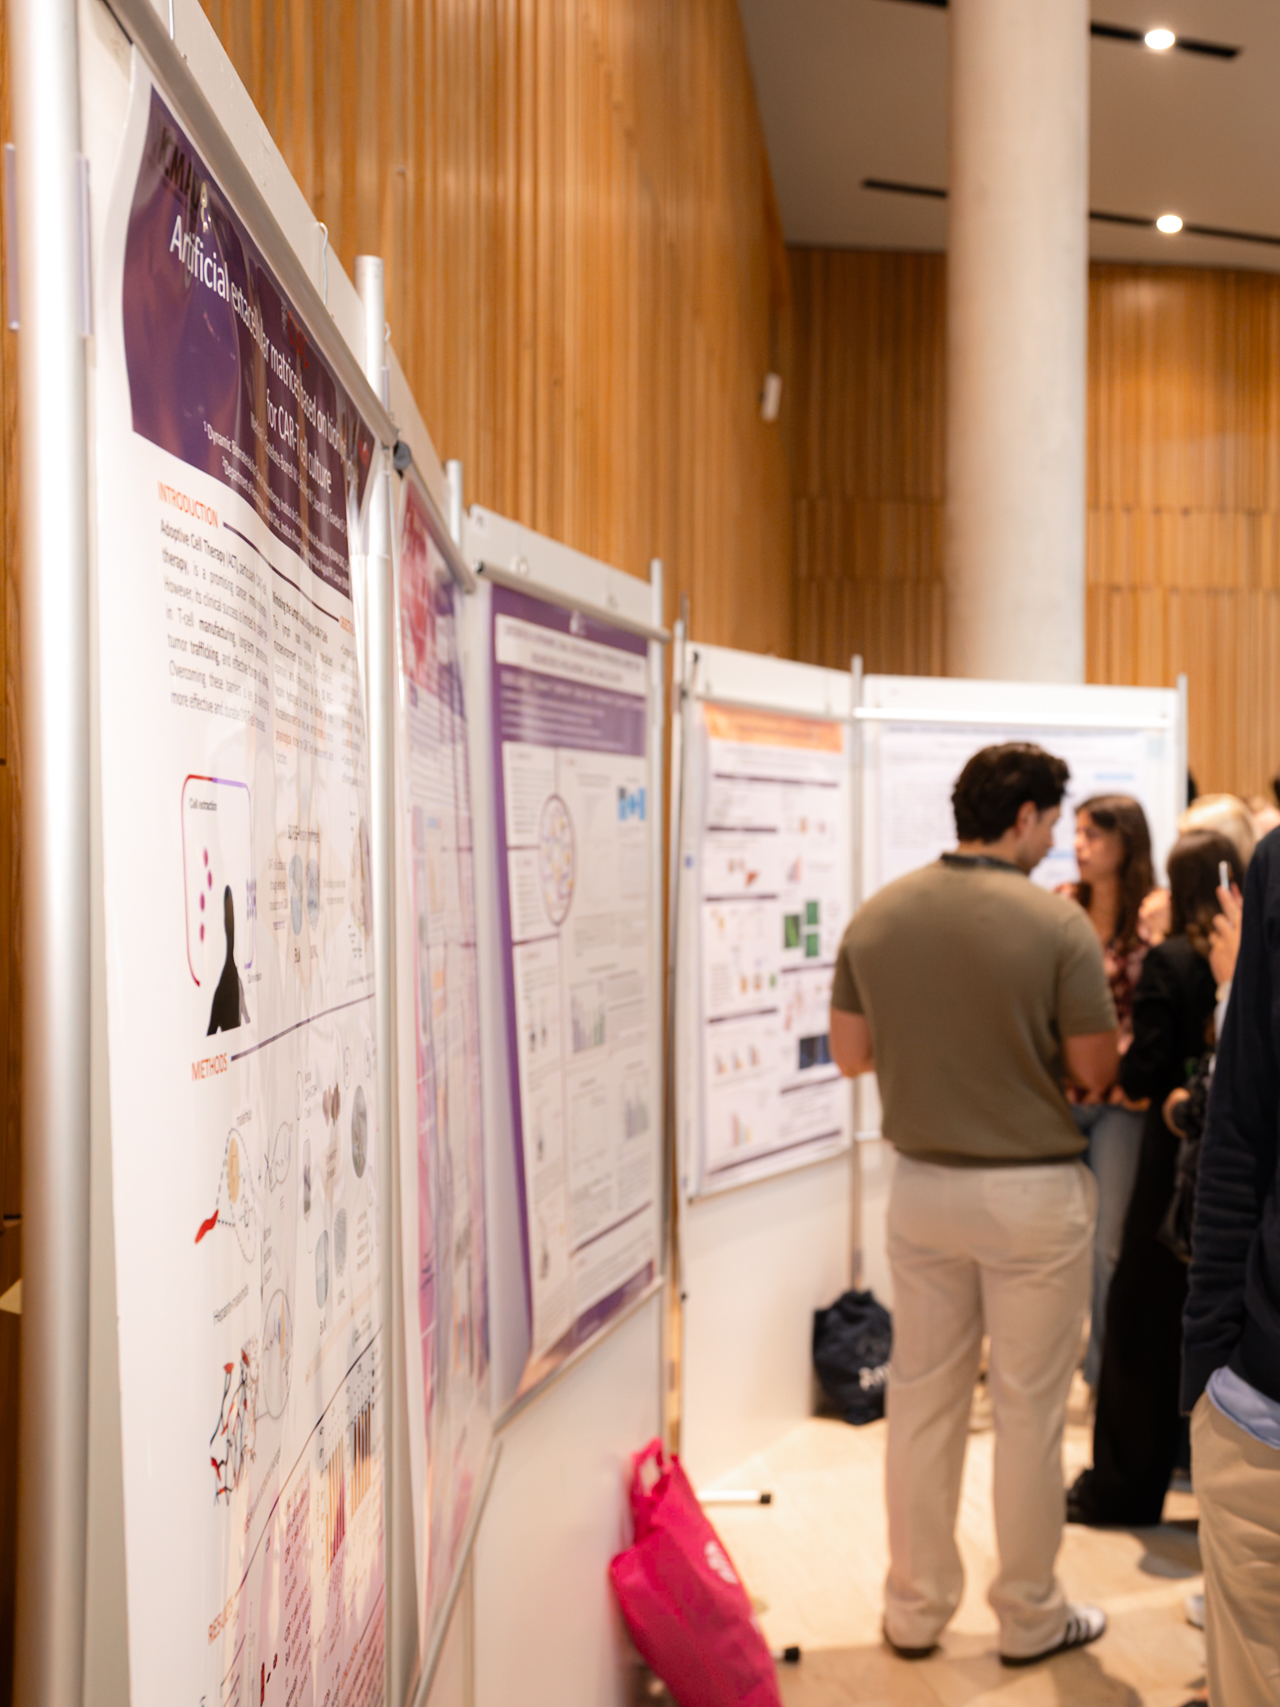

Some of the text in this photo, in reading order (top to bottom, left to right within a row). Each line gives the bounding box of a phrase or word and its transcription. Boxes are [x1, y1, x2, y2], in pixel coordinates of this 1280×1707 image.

[169, 214, 229, 302] Artificial
[157, 480, 218, 528] INTRODUCTION
[160, 519, 190, 546] Adoptive
[191, 533, 202, 552] Cell
[204, 539, 225, 567] Therapy
[176, 606, 194, 628] T-cell
[168, 659, 206, 689] Overcoming
[171, 692, 188, 707] more
[191, 1052, 228, 1082] METHODS
